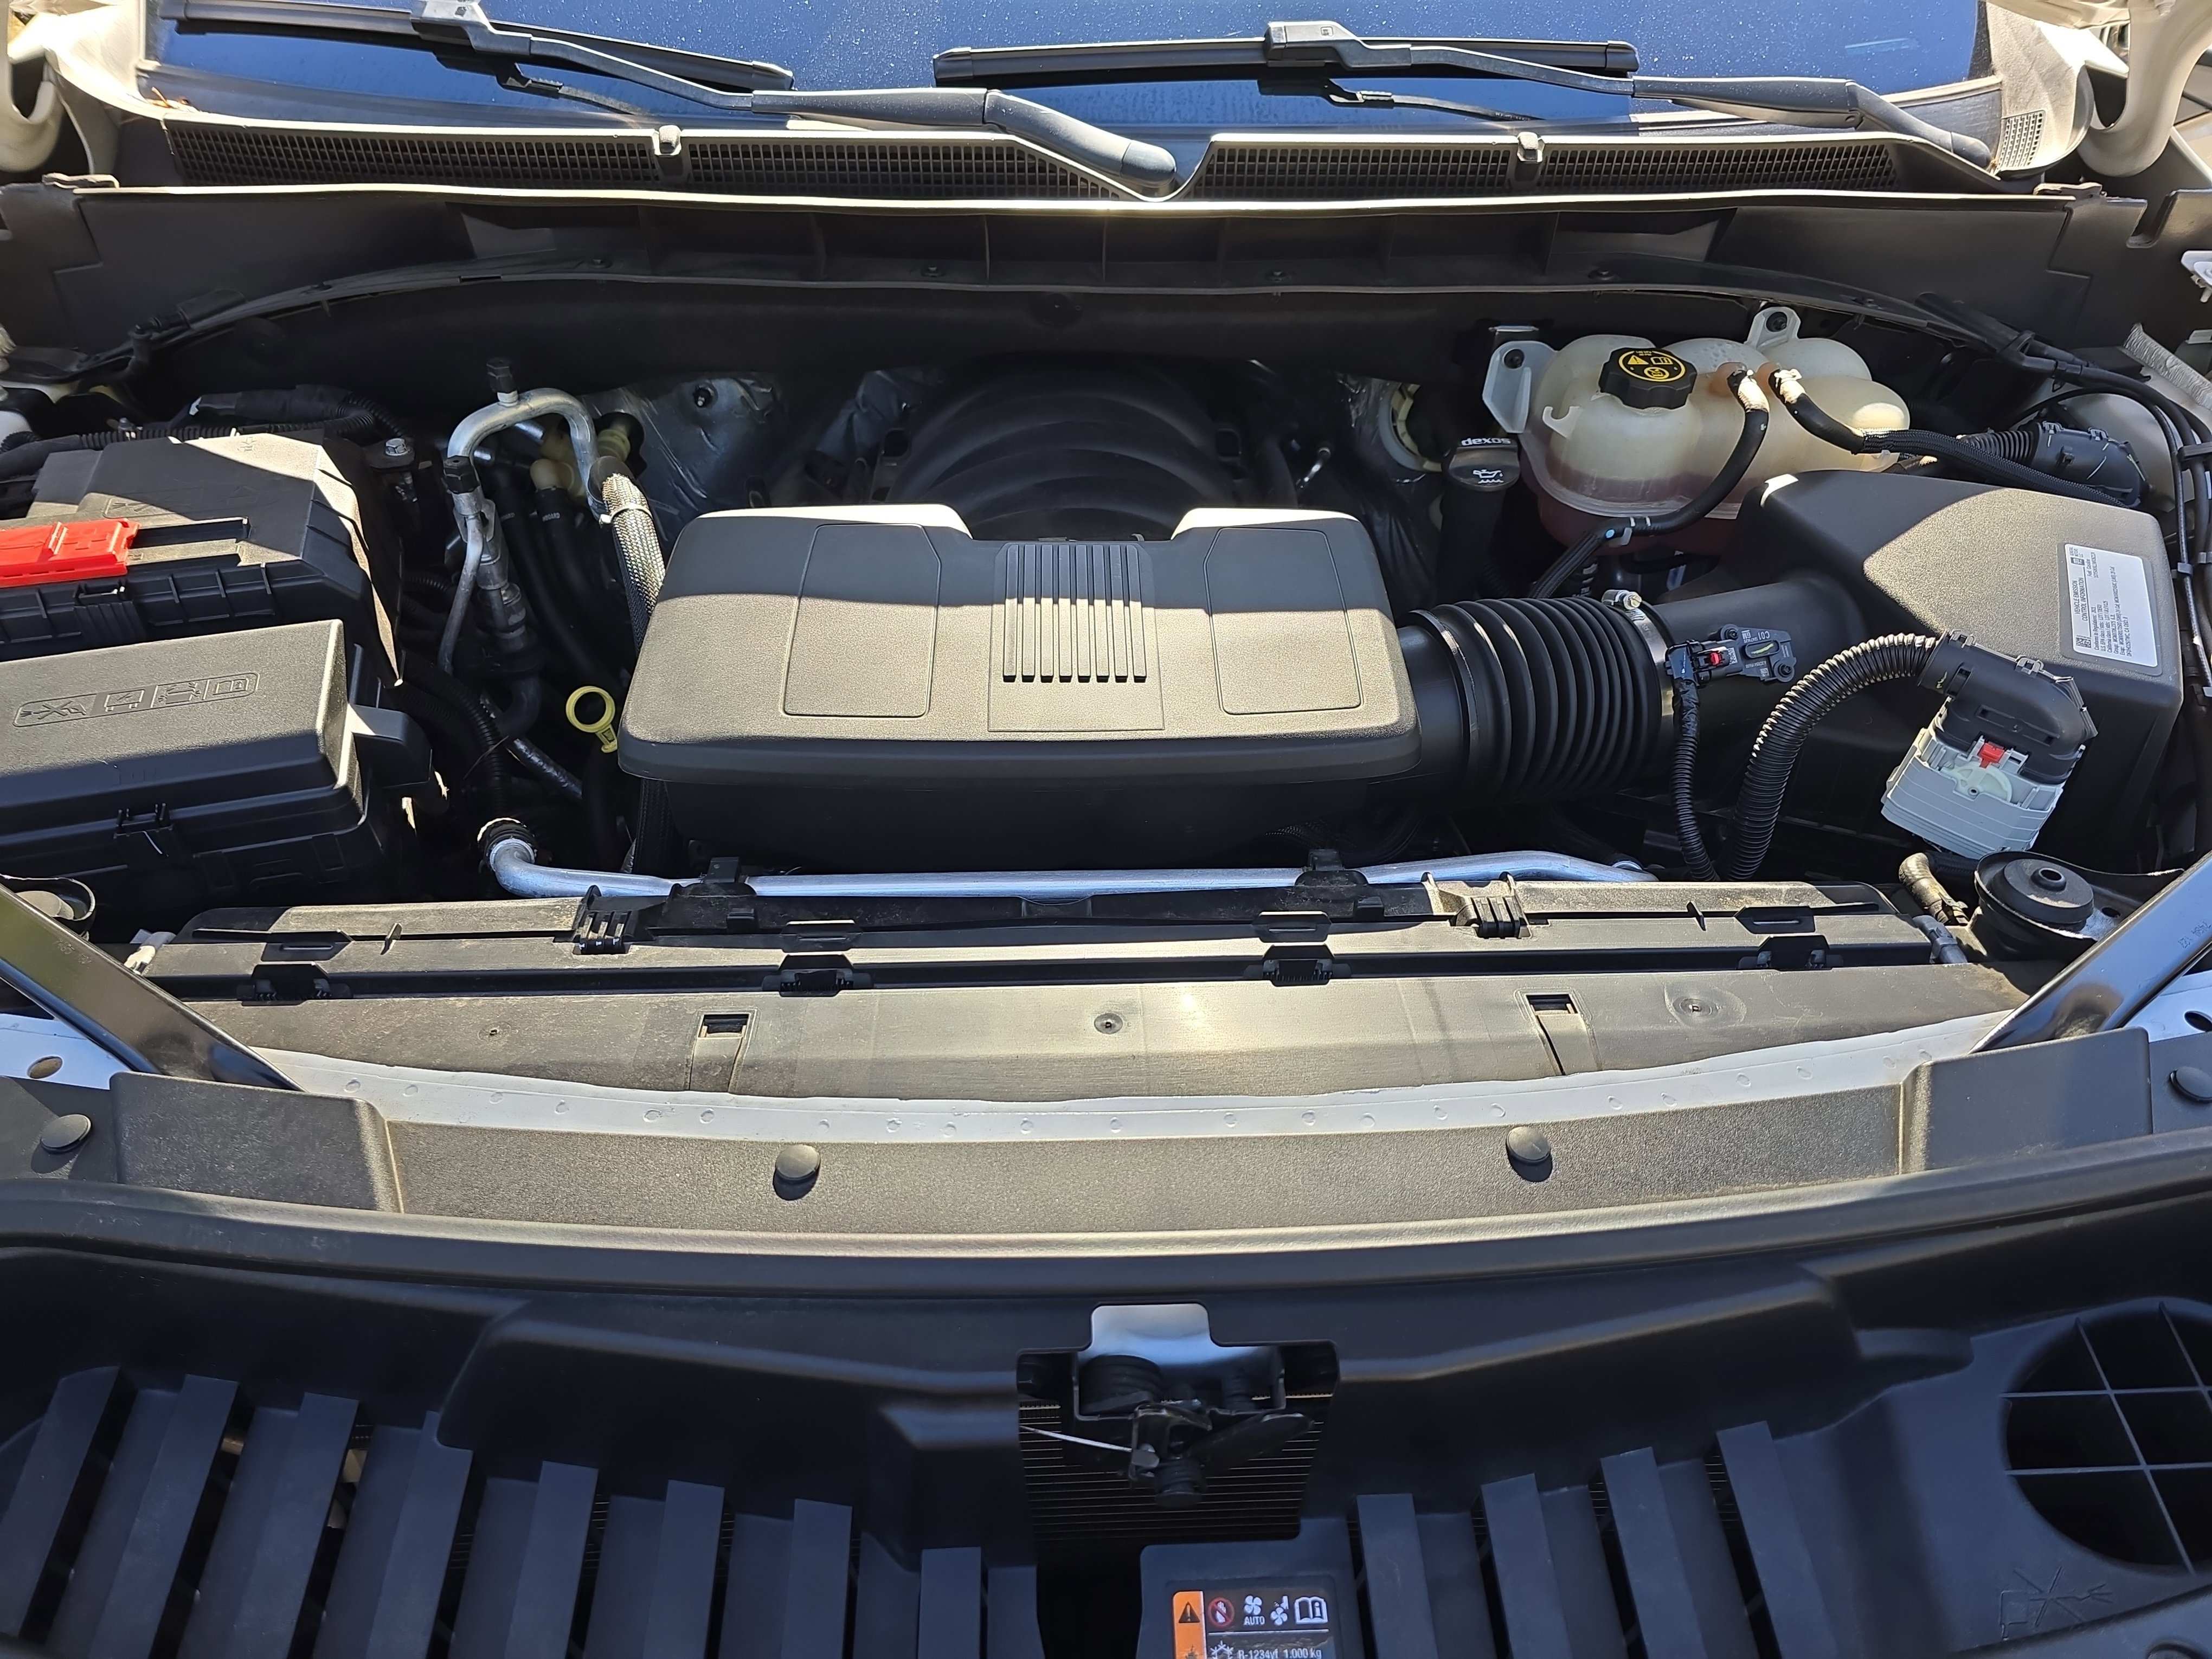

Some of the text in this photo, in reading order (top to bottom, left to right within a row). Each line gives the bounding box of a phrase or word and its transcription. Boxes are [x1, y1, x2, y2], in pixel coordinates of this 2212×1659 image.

[1741, 630, 1751, 640] GM
[1758, 631, 1770, 640] C01
[1243, 1616, 1265, 1625] AUTO
[1238, 1648, 1322, 1659] R-1234yf 1.000 kg
